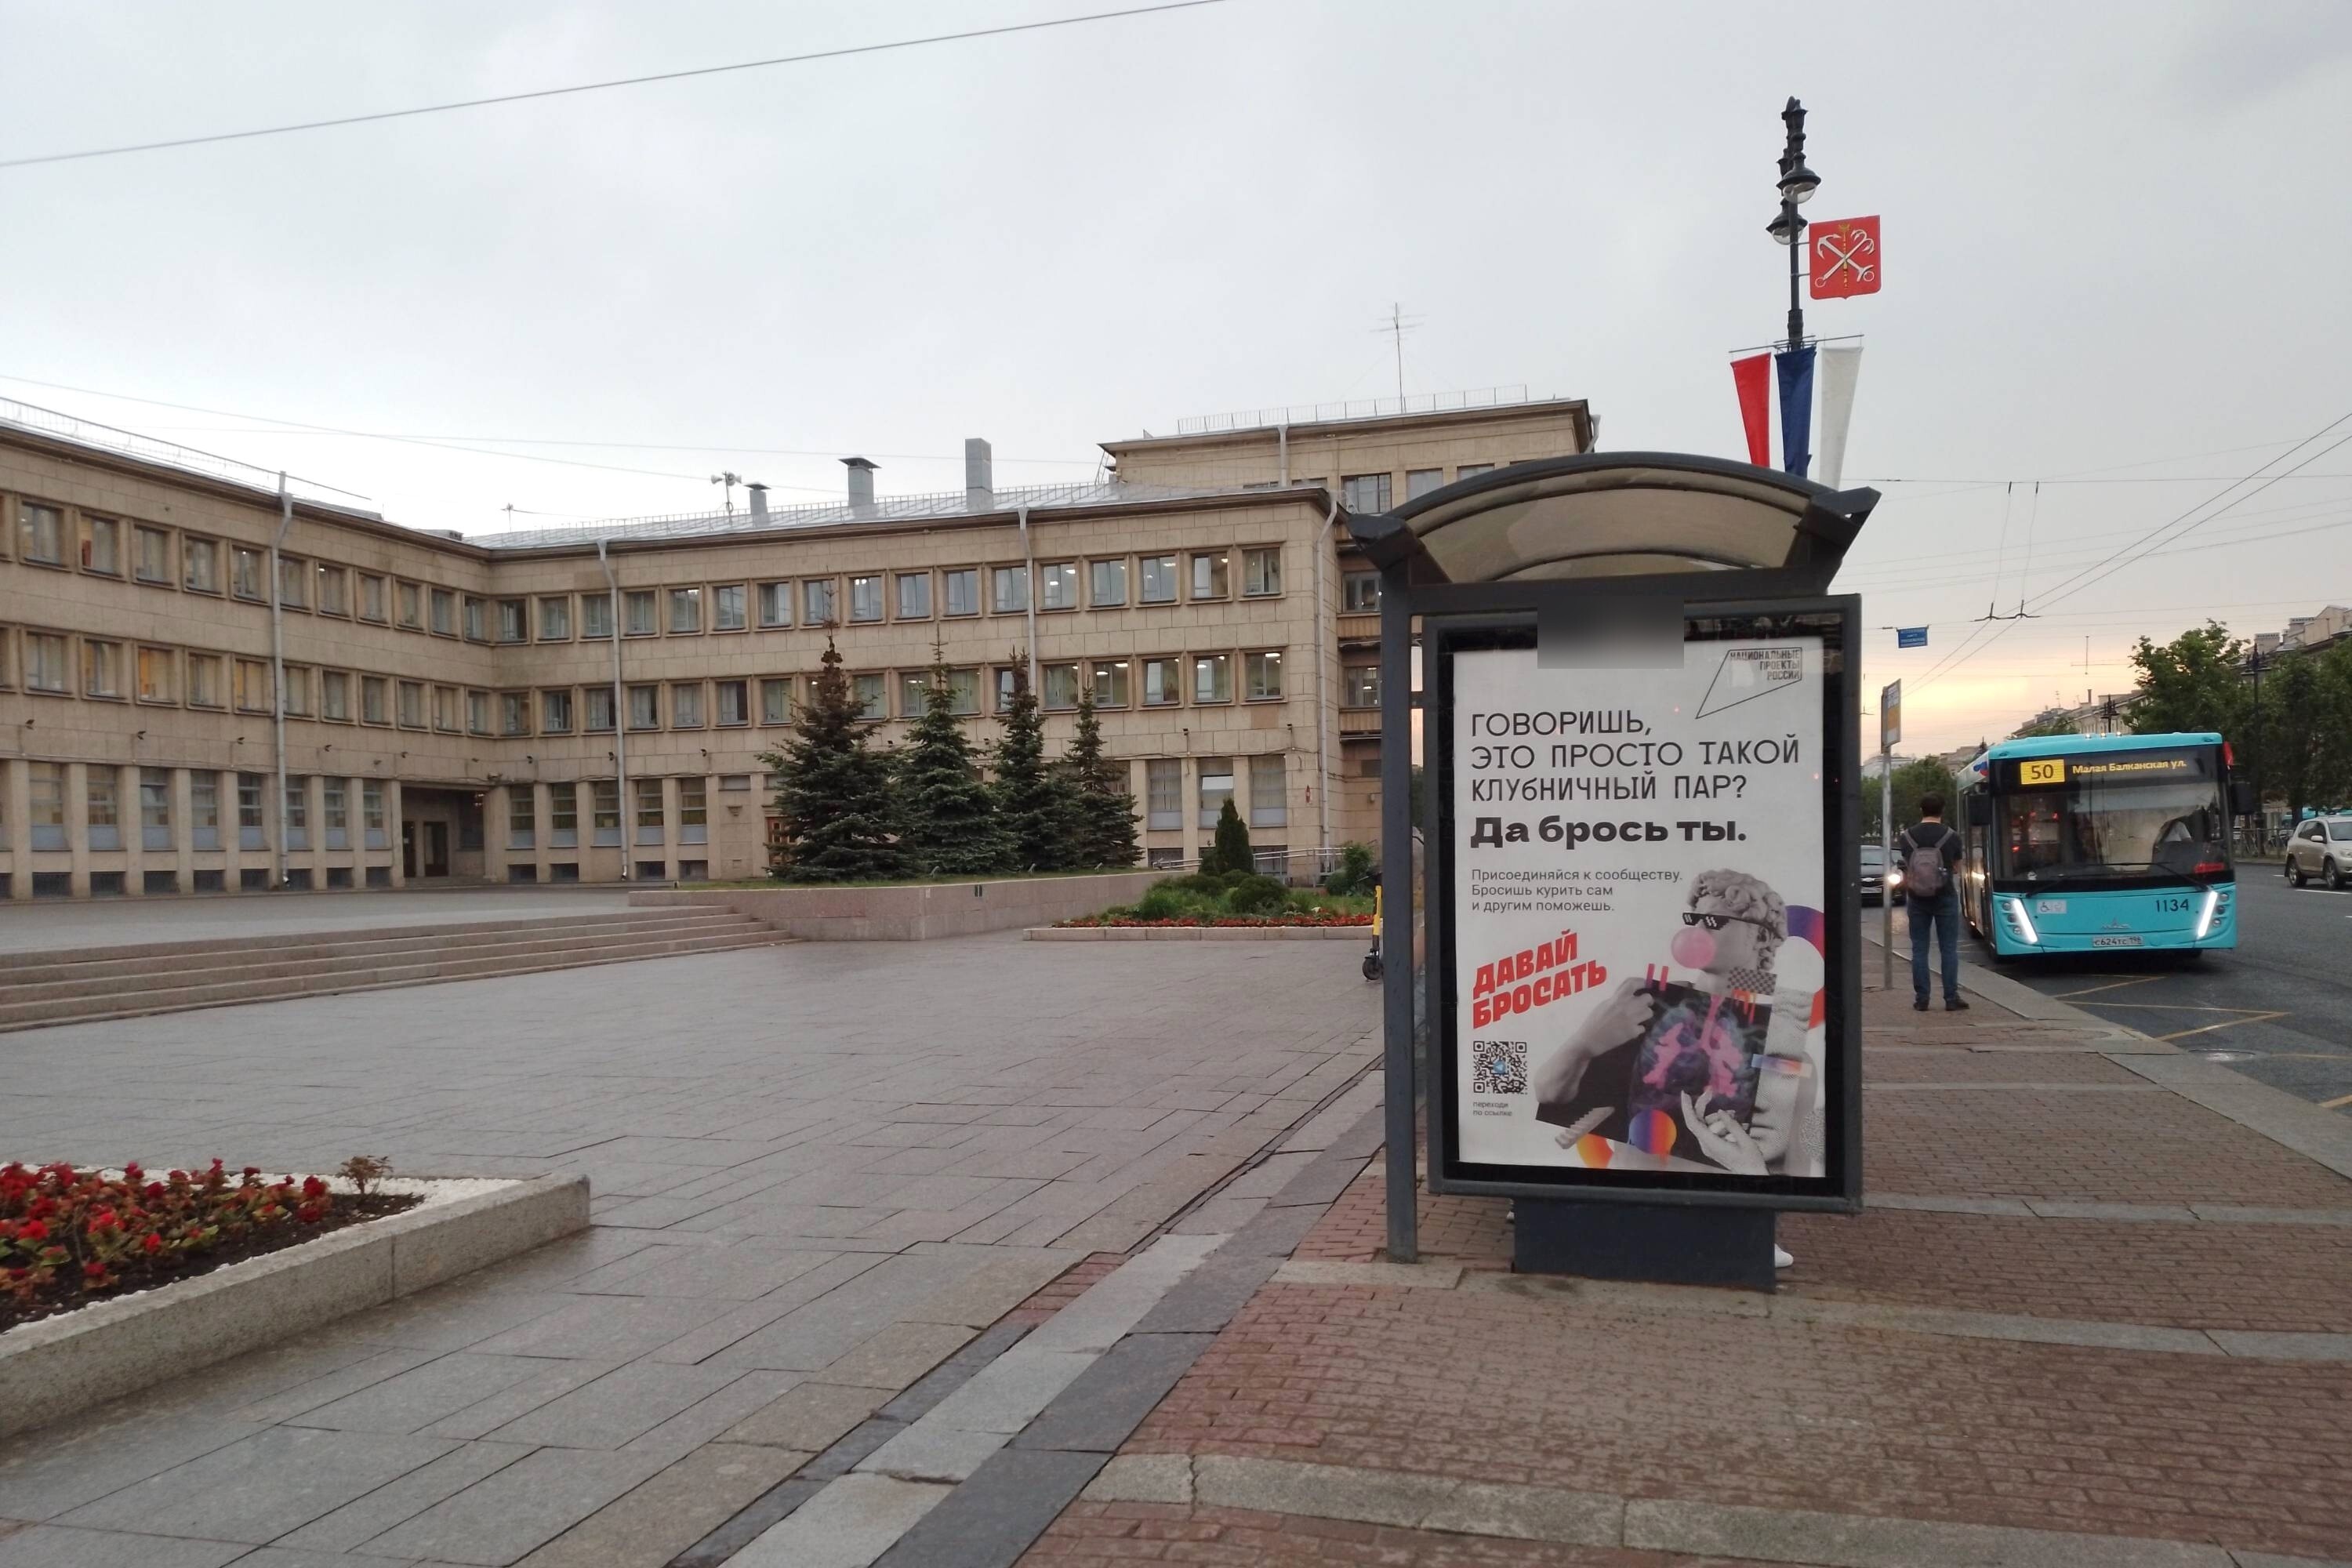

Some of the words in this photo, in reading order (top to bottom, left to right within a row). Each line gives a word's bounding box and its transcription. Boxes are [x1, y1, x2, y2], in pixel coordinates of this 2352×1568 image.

[1730, 650, 1800, 660] НАЦИОНАЛЬНЫЕ
[1759, 660, 1800, 670] ПРОЕКТЫ
[1767, 670, 1800, 680] РОССИИ
[1471, 710, 1652, 736] ГОВОРИШЬ,
[1471, 745, 1535, 769] ЭТО
[1552, 742, 1683, 768] ПРОСТО
[1699, 734, 1799, 764] ТАКОЙ
[2031, 764, 2054, 780] 50
[2072, 764, 2107, 774] Малая
[2109, 760, 2169, 771] Балканская
[2171, 760, 2187, 769] ул.
[1675, 775, 1747, 799] ПАР?
[1470, 817, 1530, 848] Да
[1538, 815, 1668, 850] брось
[1677, 820, 1747, 841] ты.
[1472, 869, 1580, 883] Присоединяйся
[1584, 871, 1591, 880] к
[1595, 869, 1683, 884] сообществу.
[1472, 884, 1532, 898] Бросишь
[1536, 887, 1583, 898] курить
[1586, 887, 1613, 895] сам
[1483, 902, 1532, 913] другим
[1536, 902, 1615, 911] поможешь.
[2156, 898, 2189, 913] 1134
[1472, 928, 1577, 1000] ДАВАЙ
[1472, 960, 1607, 1029] БРОСАТЬ
